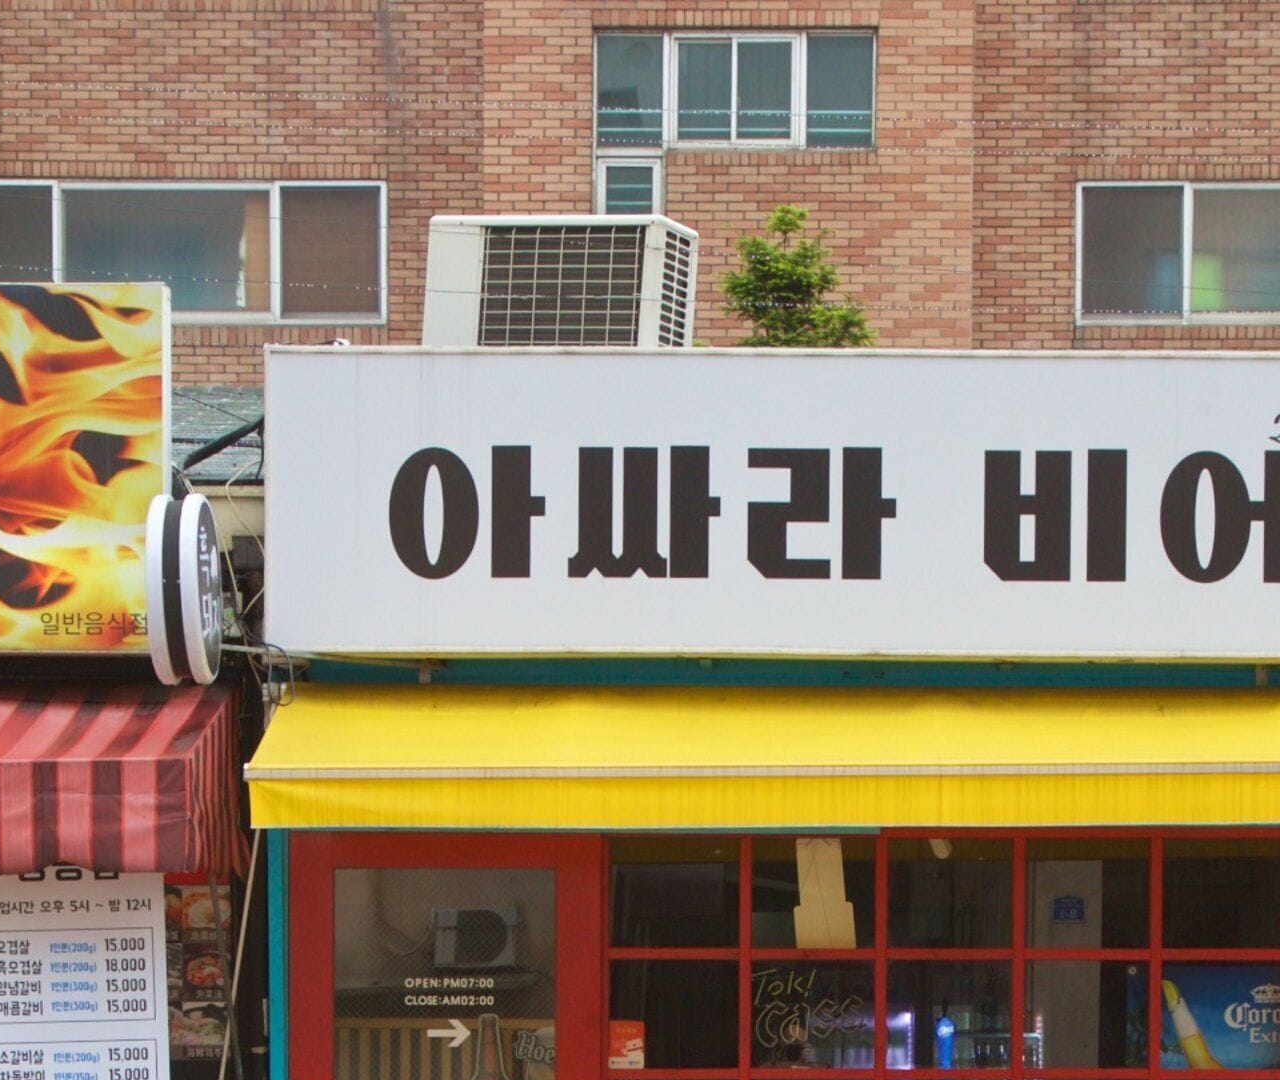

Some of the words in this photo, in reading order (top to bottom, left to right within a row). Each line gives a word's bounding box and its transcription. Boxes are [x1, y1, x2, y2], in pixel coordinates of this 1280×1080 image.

[389, 445, 897, 580] 아싸라
[39, 612, 149, 637] 일반음식점
[40, 899, 65, 914] 오후
[69, 899, 90, 913] 5시
[109, 899, 121, 913] 밤
[126, 898, 151, 912] 12시
[0, 1049, 44, 1065] 소갈비살
